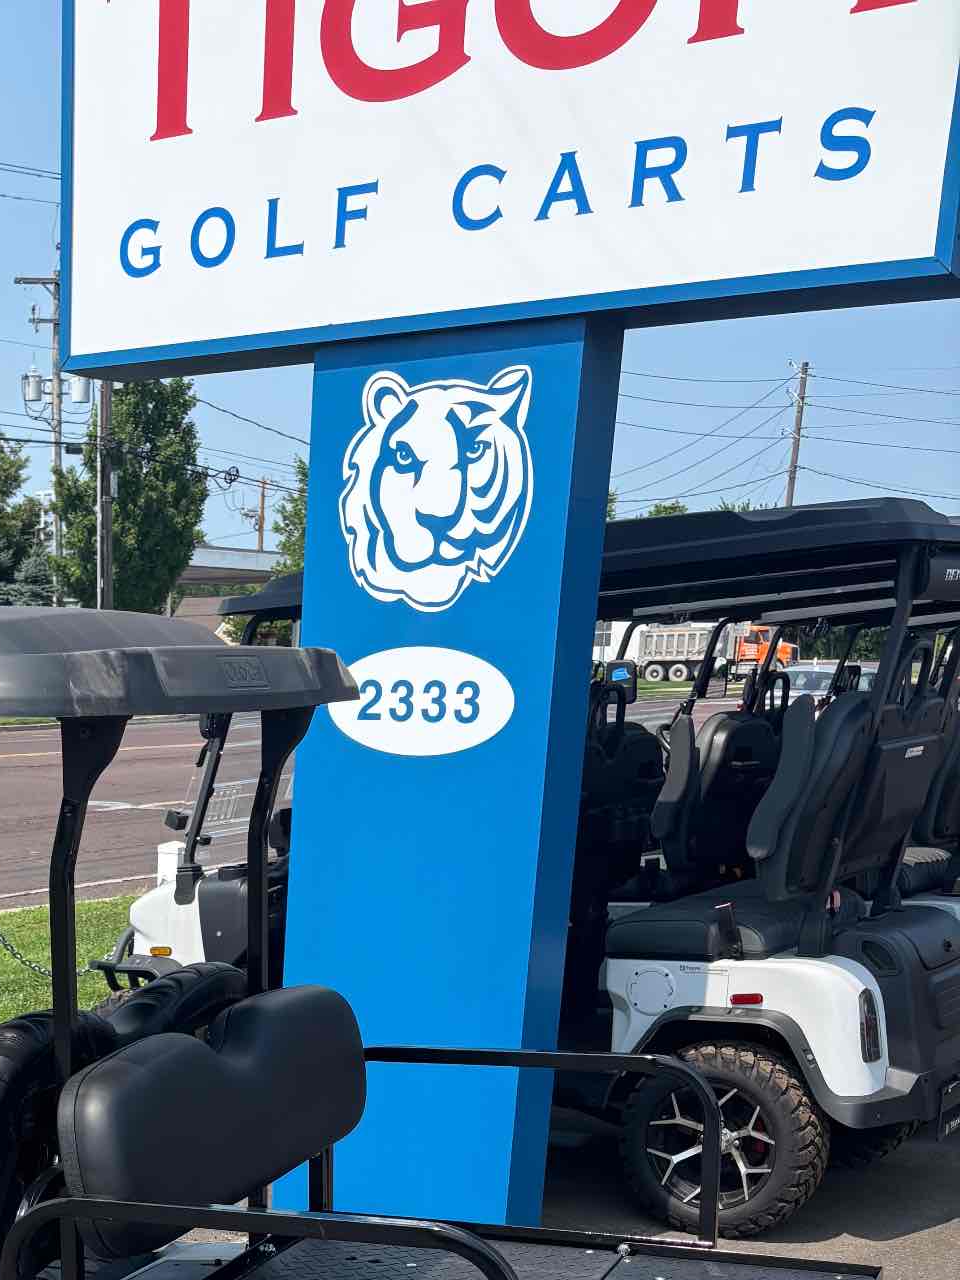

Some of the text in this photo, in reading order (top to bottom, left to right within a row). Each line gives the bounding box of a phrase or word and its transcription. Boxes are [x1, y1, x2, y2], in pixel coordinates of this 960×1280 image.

[119, 107, 876, 278] GOLF CARTS
[356, 678, 481, 724] 2333
